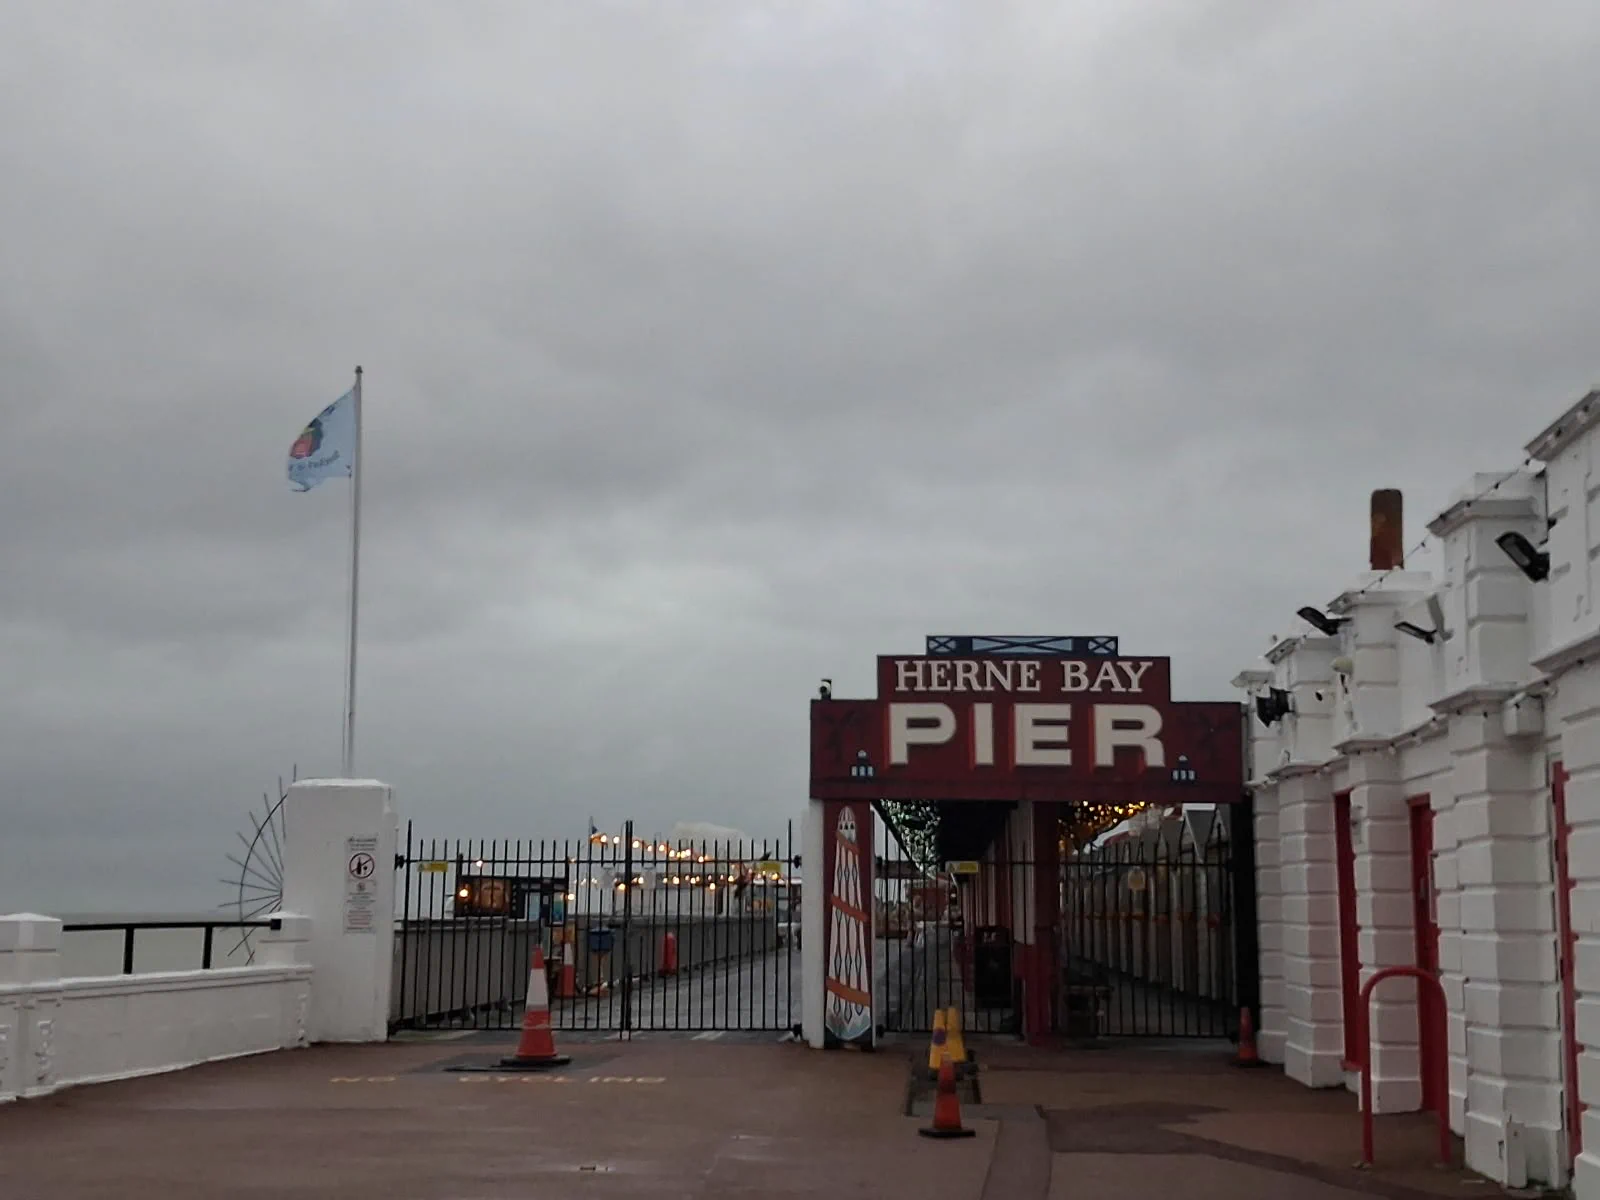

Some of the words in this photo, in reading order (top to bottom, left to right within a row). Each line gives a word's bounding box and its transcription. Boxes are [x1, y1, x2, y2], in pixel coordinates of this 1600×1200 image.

[894, 659, 1041, 692] HERNE
[1060, 660, 1153, 693] BAY
[887, 702, 1166, 768] PIER
